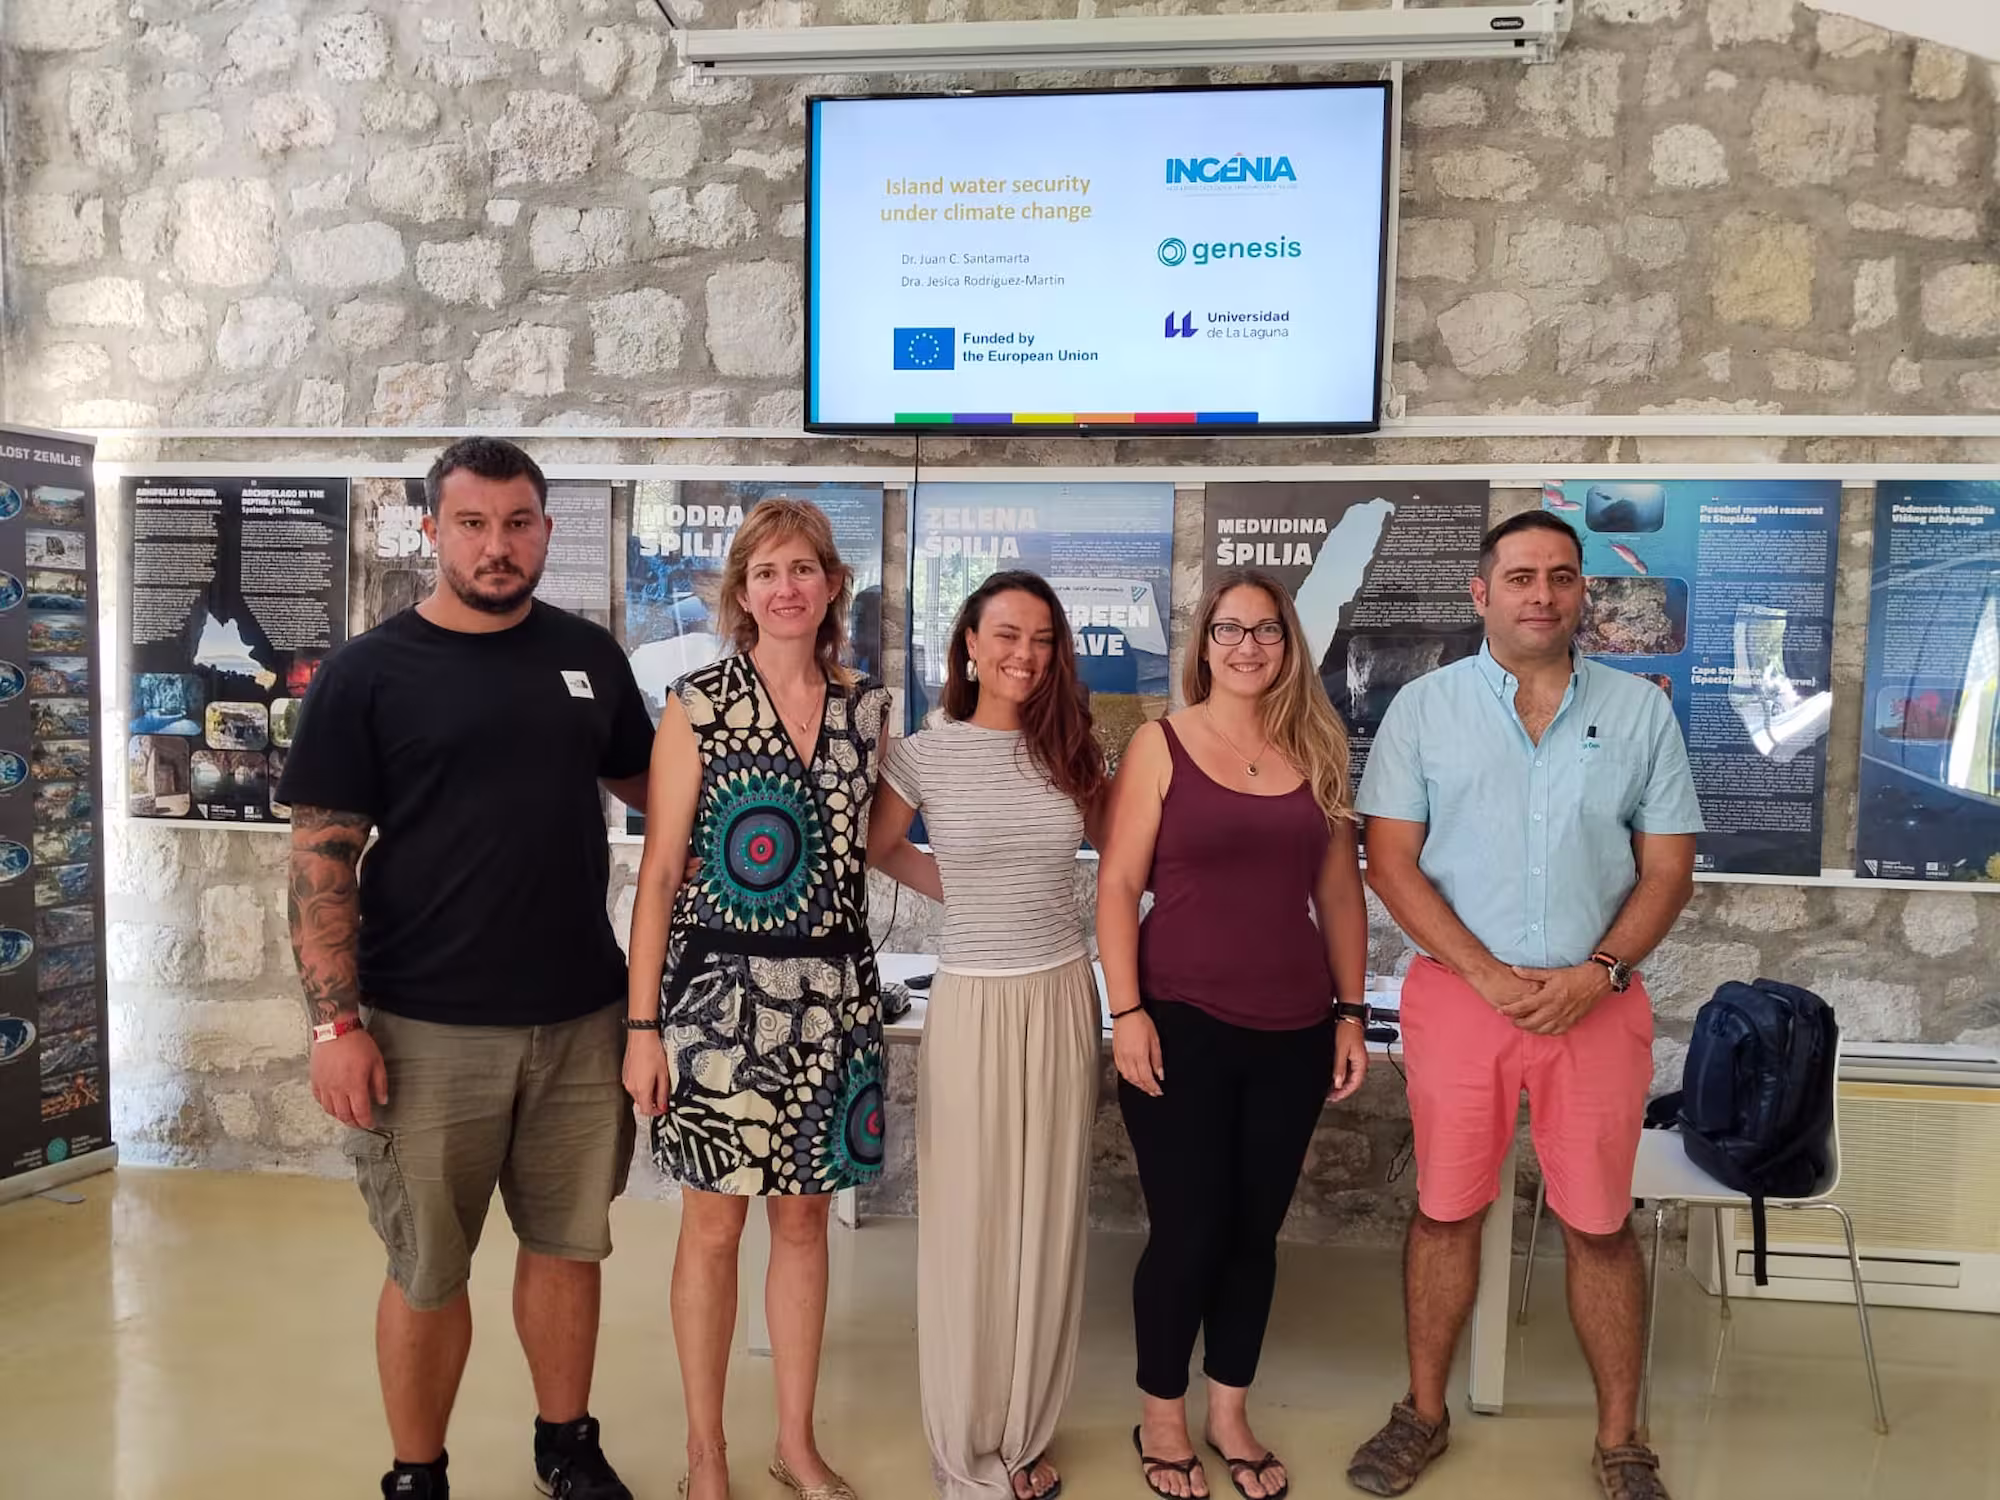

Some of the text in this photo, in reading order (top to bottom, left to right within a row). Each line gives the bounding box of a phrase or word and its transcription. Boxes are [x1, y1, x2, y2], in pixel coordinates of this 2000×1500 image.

[886, 175, 1091, 196] Island water security
[881, 201, 1092, 222] under climate change
[902, 253, 1030, 265] Dr. Juan C. Santamarta
[1192, 235, 1302, 265] genesis
[902, 276, 924, 287] Dra.
[927, 276, 960, 287] Jesica
[1207, 310, 1290, 323] Universidad
[963, 332, 1035, 347] Funded by
[1207, 327, 1289, 340] de La Laguna
[963, 349, 1099, 365] the European Union
[0, 445, 82, 467] LOST ZEMLJE
[925, 507, 1037, 529] ZELENA
[1217, 518, 1328, 534] MEDVIDINA
[926, 530, 1020, 559] ŠPILJA
[1216, 537, 1314, 566] ŠPILJA
[1073, 633, 1124, 656] AVE
